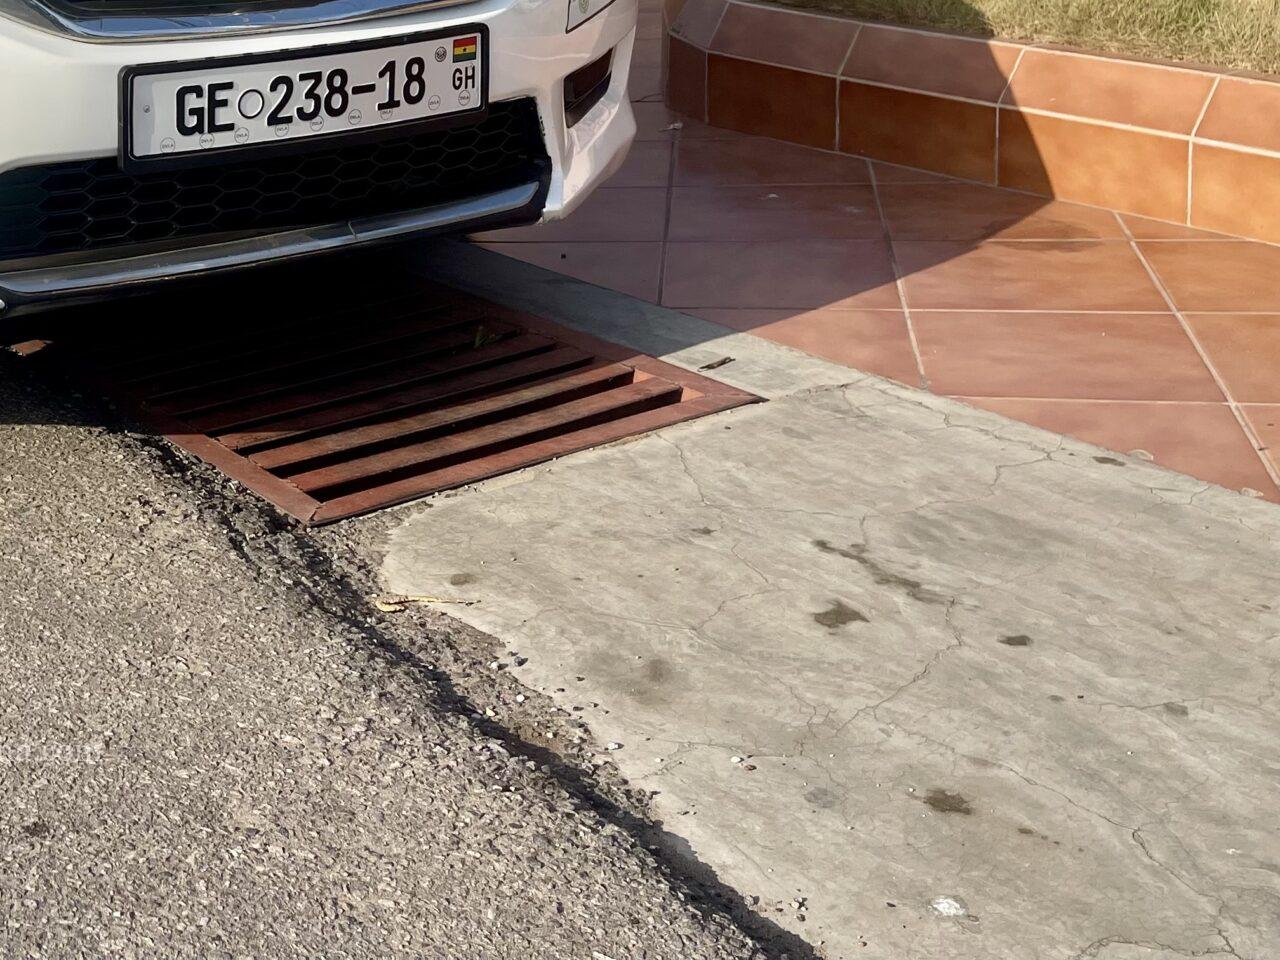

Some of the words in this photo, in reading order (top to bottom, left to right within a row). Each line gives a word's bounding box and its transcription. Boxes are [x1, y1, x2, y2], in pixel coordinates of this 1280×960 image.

[176, 81, 235, 136] GE
[267, 56, 426, 126] 238-18
[452, 64, 476, 91] GH
